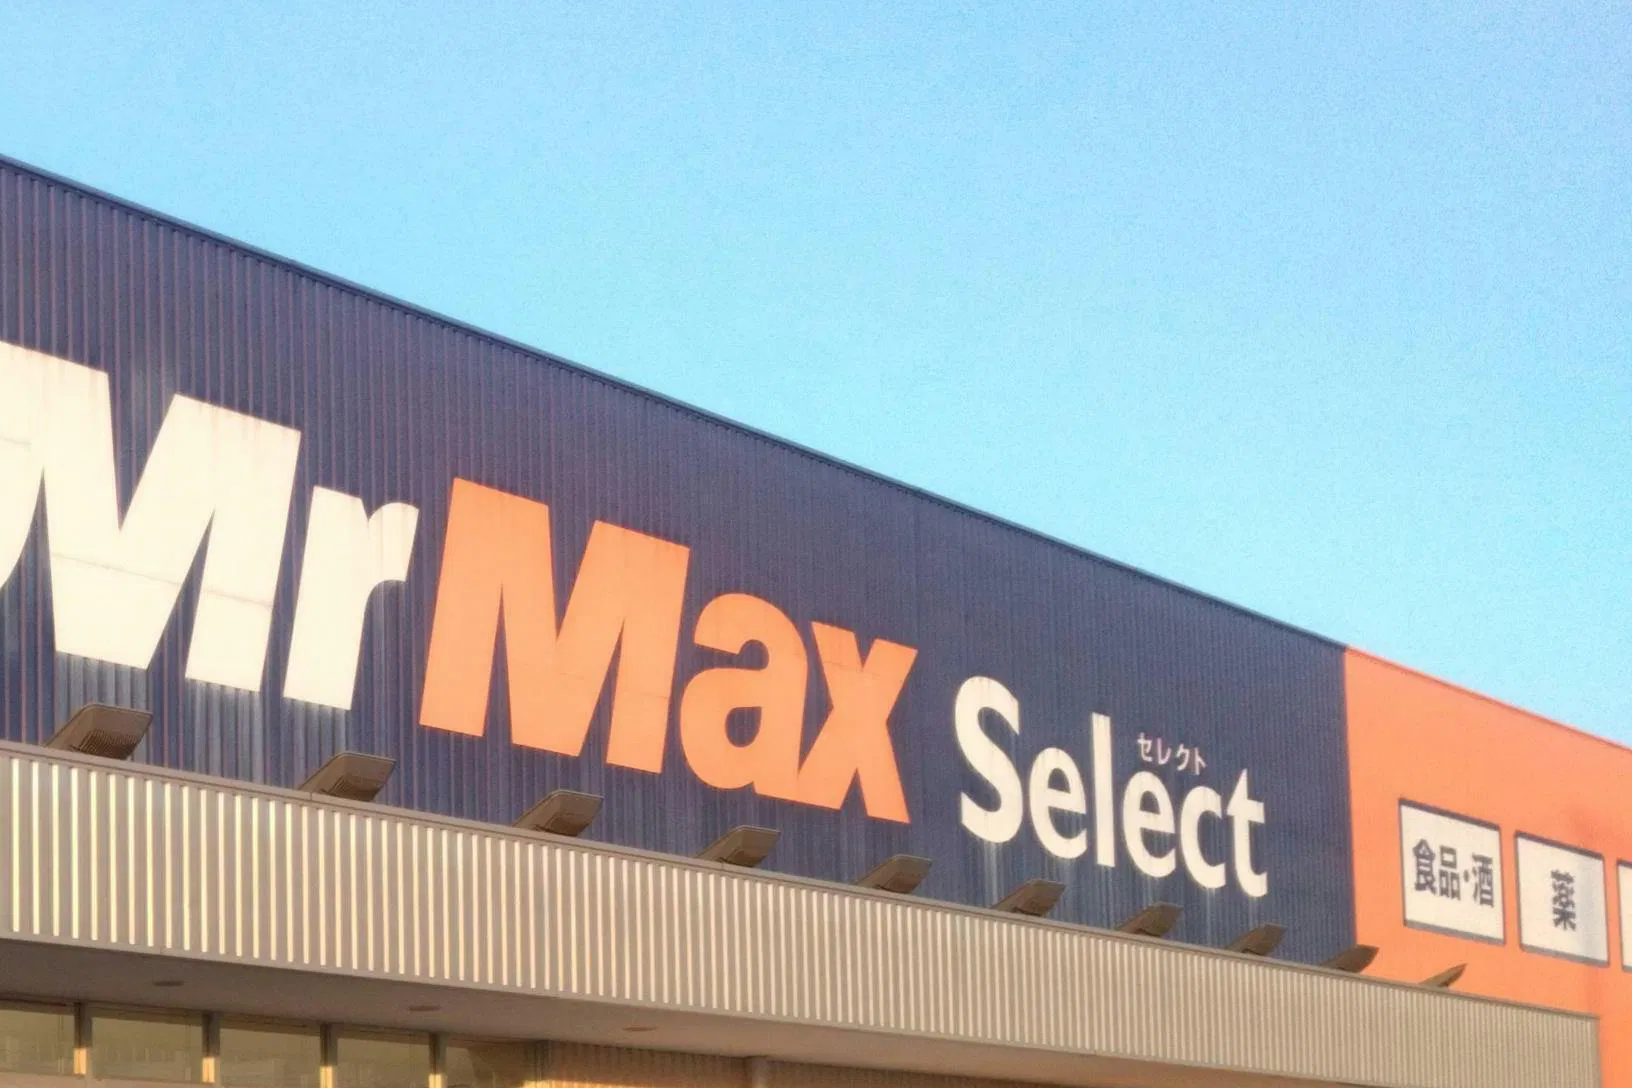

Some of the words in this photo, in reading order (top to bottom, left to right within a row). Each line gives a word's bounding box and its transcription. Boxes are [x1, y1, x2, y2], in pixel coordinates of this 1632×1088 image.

[954, 675, 1268, 897] Select
[1137, 731, 1207, 776] セレクト
[1411, 838, 1495, 908] 食品・酒
